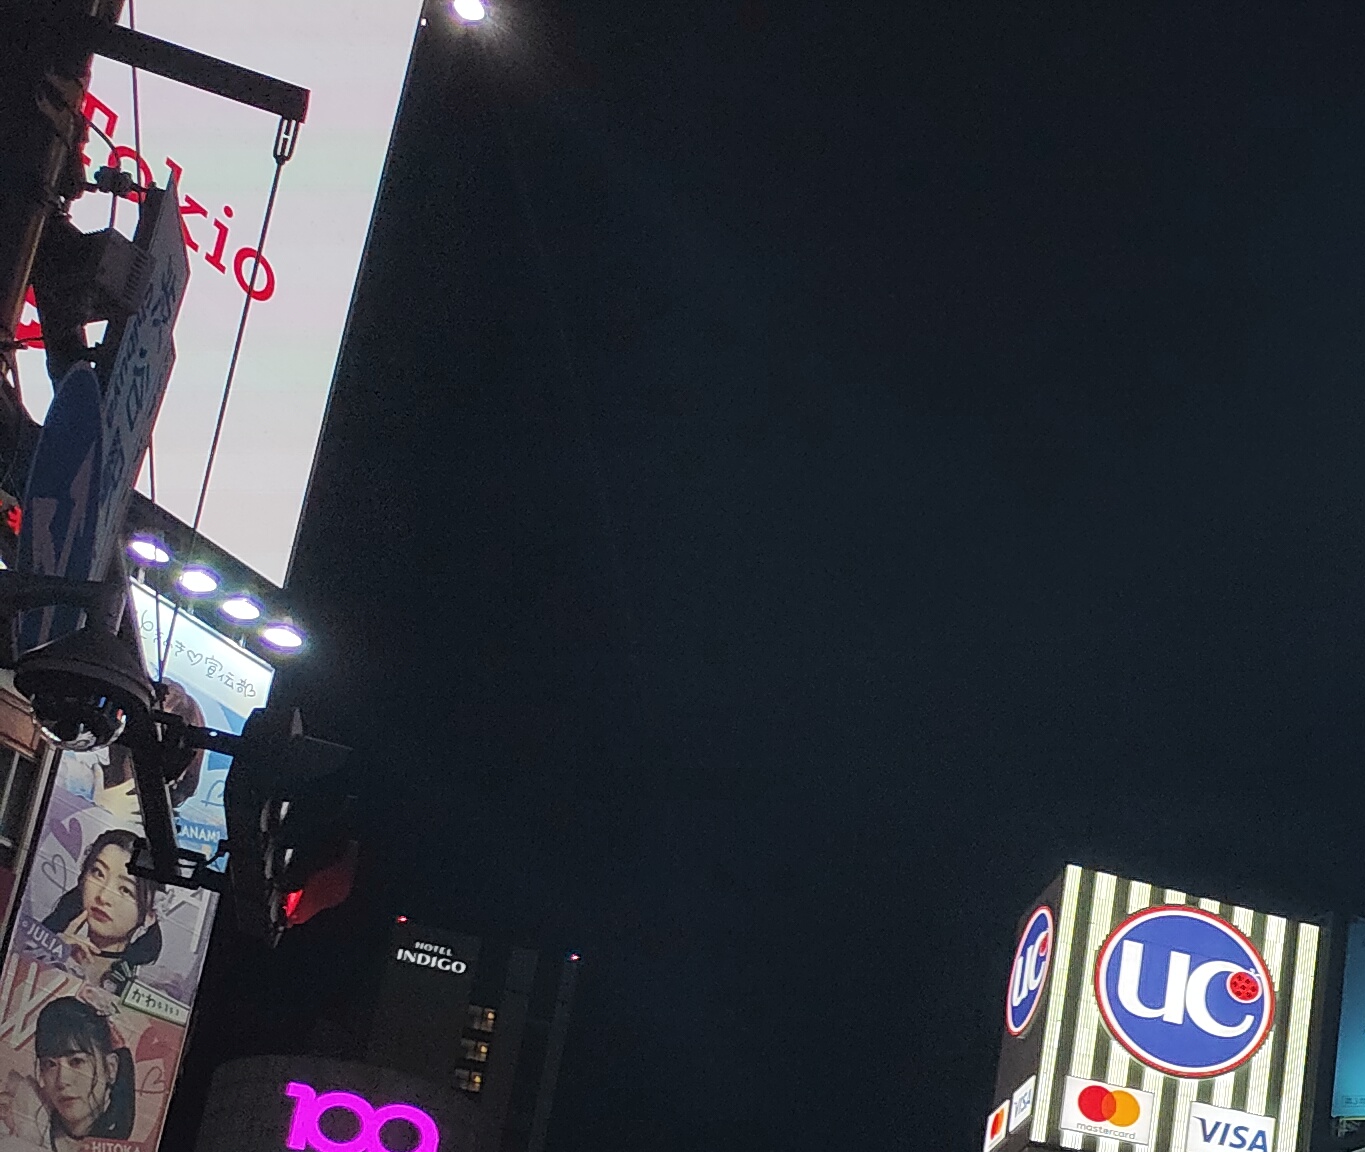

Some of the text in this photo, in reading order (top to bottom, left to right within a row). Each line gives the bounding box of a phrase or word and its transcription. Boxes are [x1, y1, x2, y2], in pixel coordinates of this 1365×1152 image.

[178, 824, 222, 843] ANAMI
[26, 922, 66, 960] JULIA
[395, 947, 468, 975] INDIGO
[129, 985, 182, 1020] かわいい
[1012, 1086, 1032, 1122] VISA
[1076, 1122, 1137, 1140] mastercard
